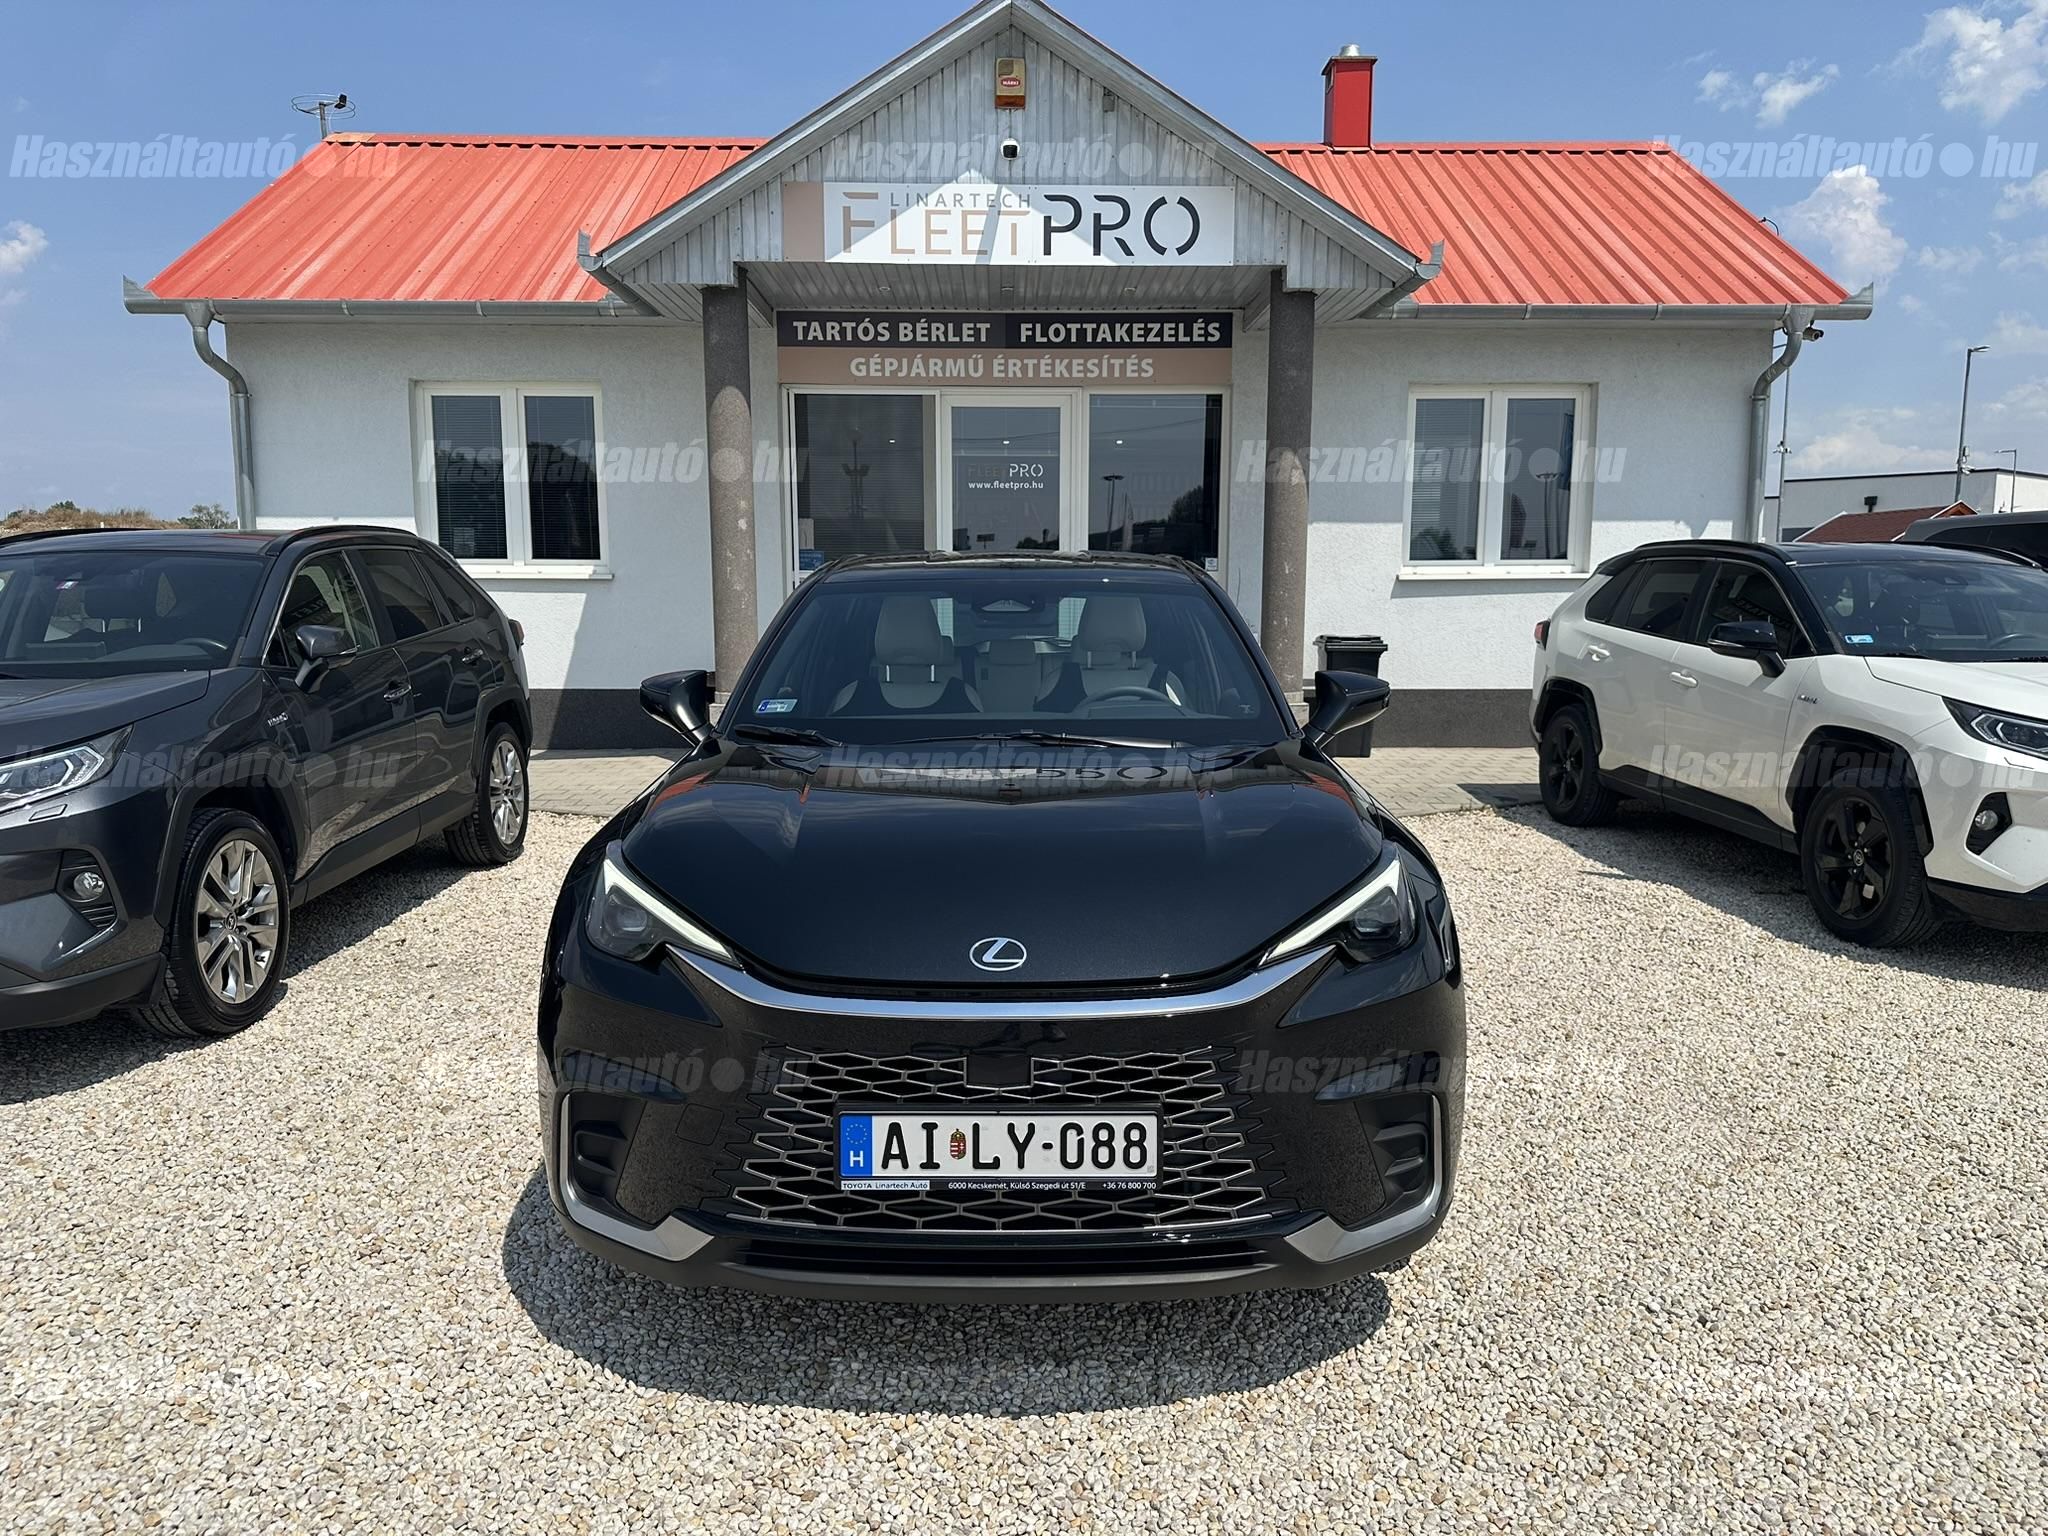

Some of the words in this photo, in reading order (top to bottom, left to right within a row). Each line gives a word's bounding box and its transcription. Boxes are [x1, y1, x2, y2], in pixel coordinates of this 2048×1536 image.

[890, 191, 1031, 208] LINARTECH
[793, 317, 890, 343] TARTÓS
[899, 317, 991, 343] BÉRLET
[1020, 317, 1221, 343] FLOTTAKEZELÉS
[849, 353, 984, 379] GÉPJÁRMŰ
[992, 353, 1154, 379] ÉRTÉKESÍTÉS
[968, 480, 1044, 491] www.fleetpro.hu
[849, 1150, 864, 1168] H
[1031, 1181, 1060, 1191] Szegedi
